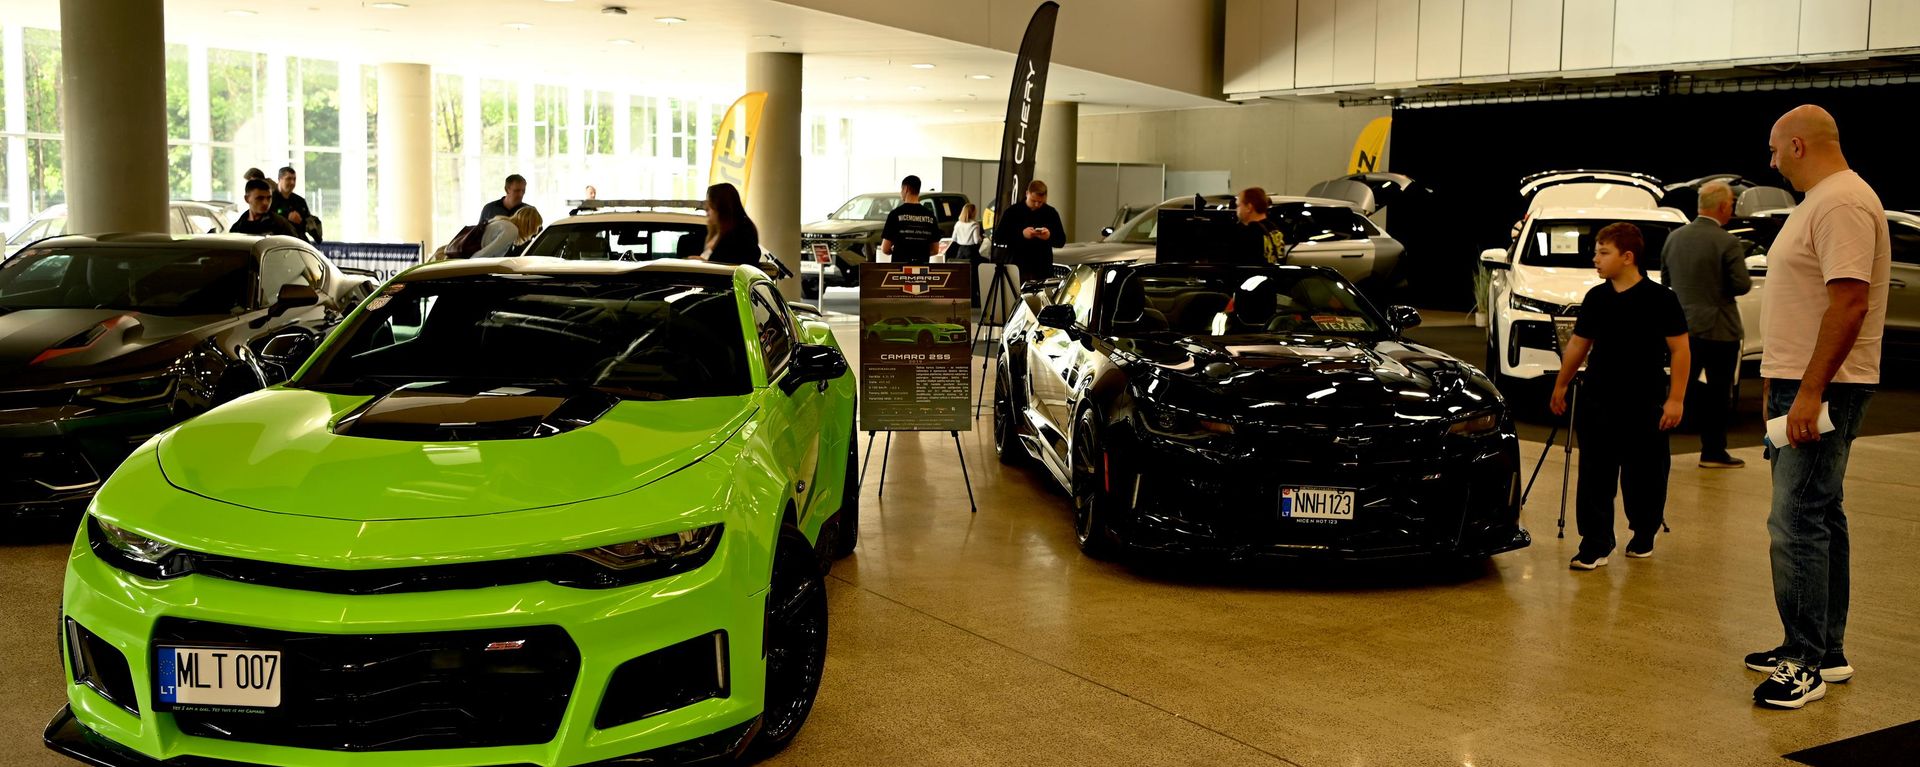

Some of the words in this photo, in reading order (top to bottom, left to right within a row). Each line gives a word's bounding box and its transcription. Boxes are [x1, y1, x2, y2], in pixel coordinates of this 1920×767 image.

[1014, 59, 1036, 165] CHERY
[1320, 322, 1366, 331] TEXAS
[176, 652, 228, 689] MLT
[236, 654, 278, 690] 007
[160, 685, 175, 695] LT
